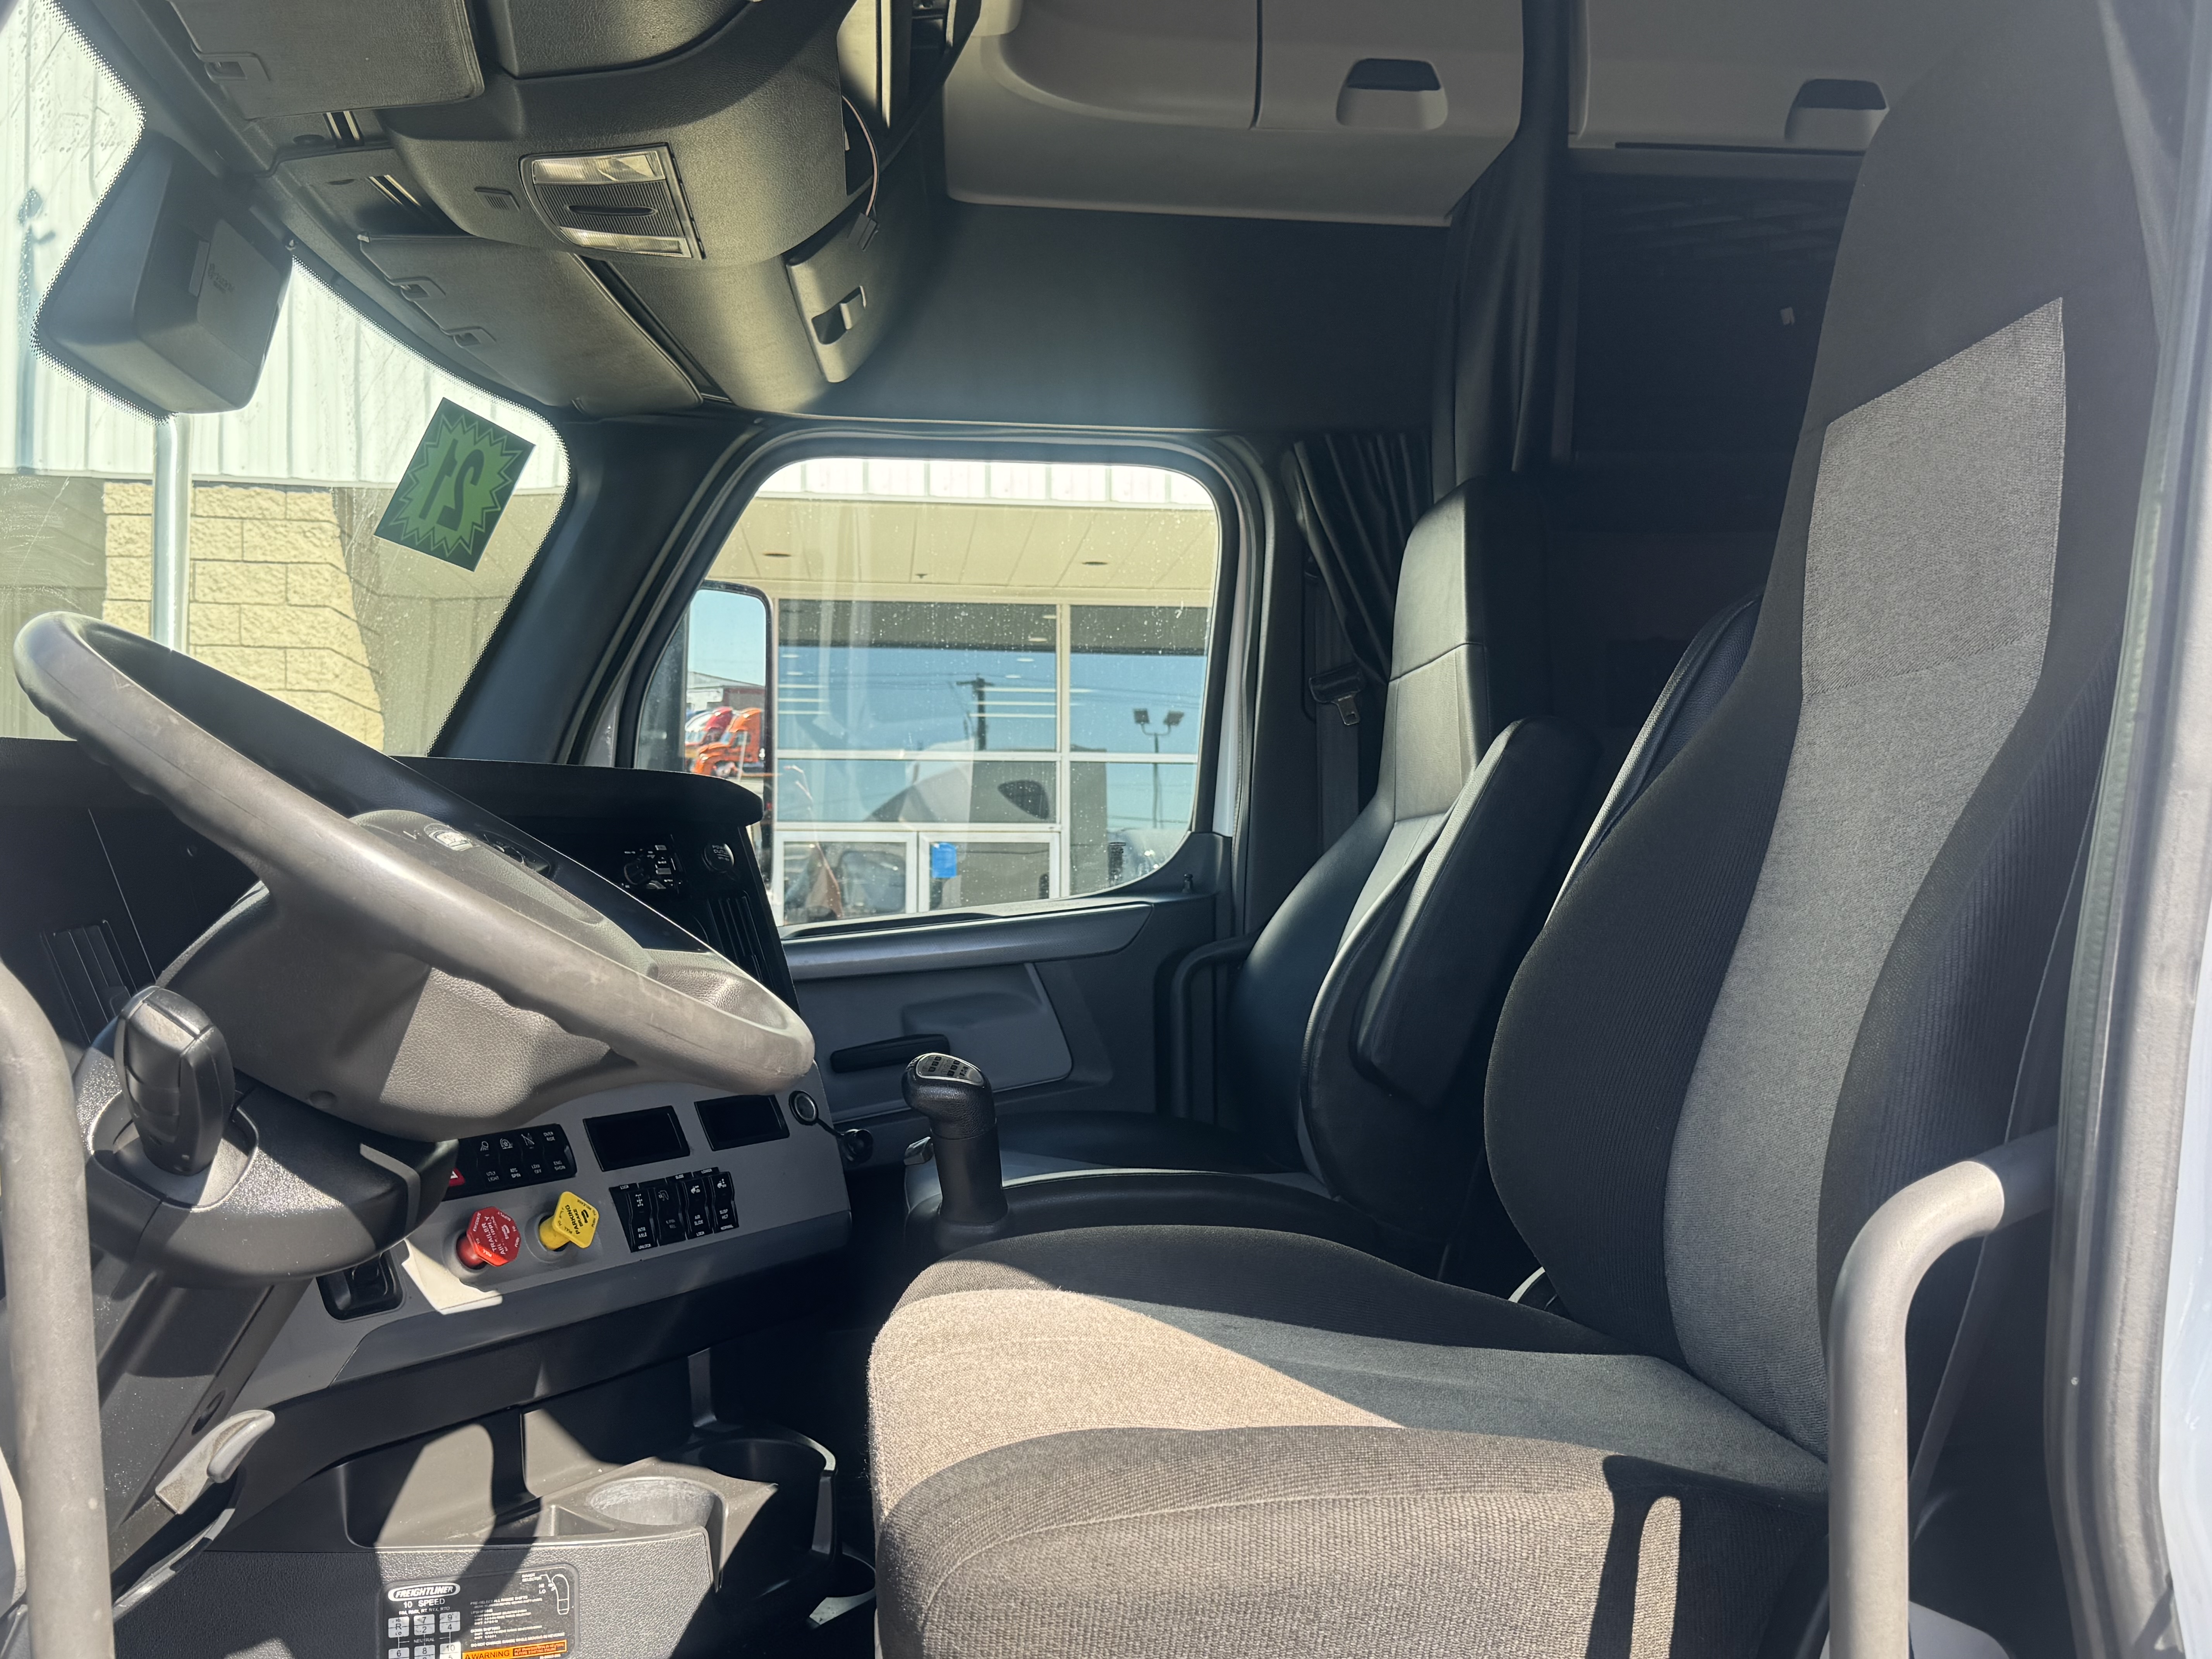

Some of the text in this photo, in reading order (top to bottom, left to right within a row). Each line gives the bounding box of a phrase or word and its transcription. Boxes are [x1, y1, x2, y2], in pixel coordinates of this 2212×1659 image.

[565, 1205, 580, 1234] PARKING
[573, 1209, 584, 1227] BRAKE
[482, 1223, 497, 1252] TRAILER
[395, 1586, 453, 1598] FREIGHTLINER
[418, 1598, 445, 1607] SPEED
[472, 1650, 510, 1659] WARNING
